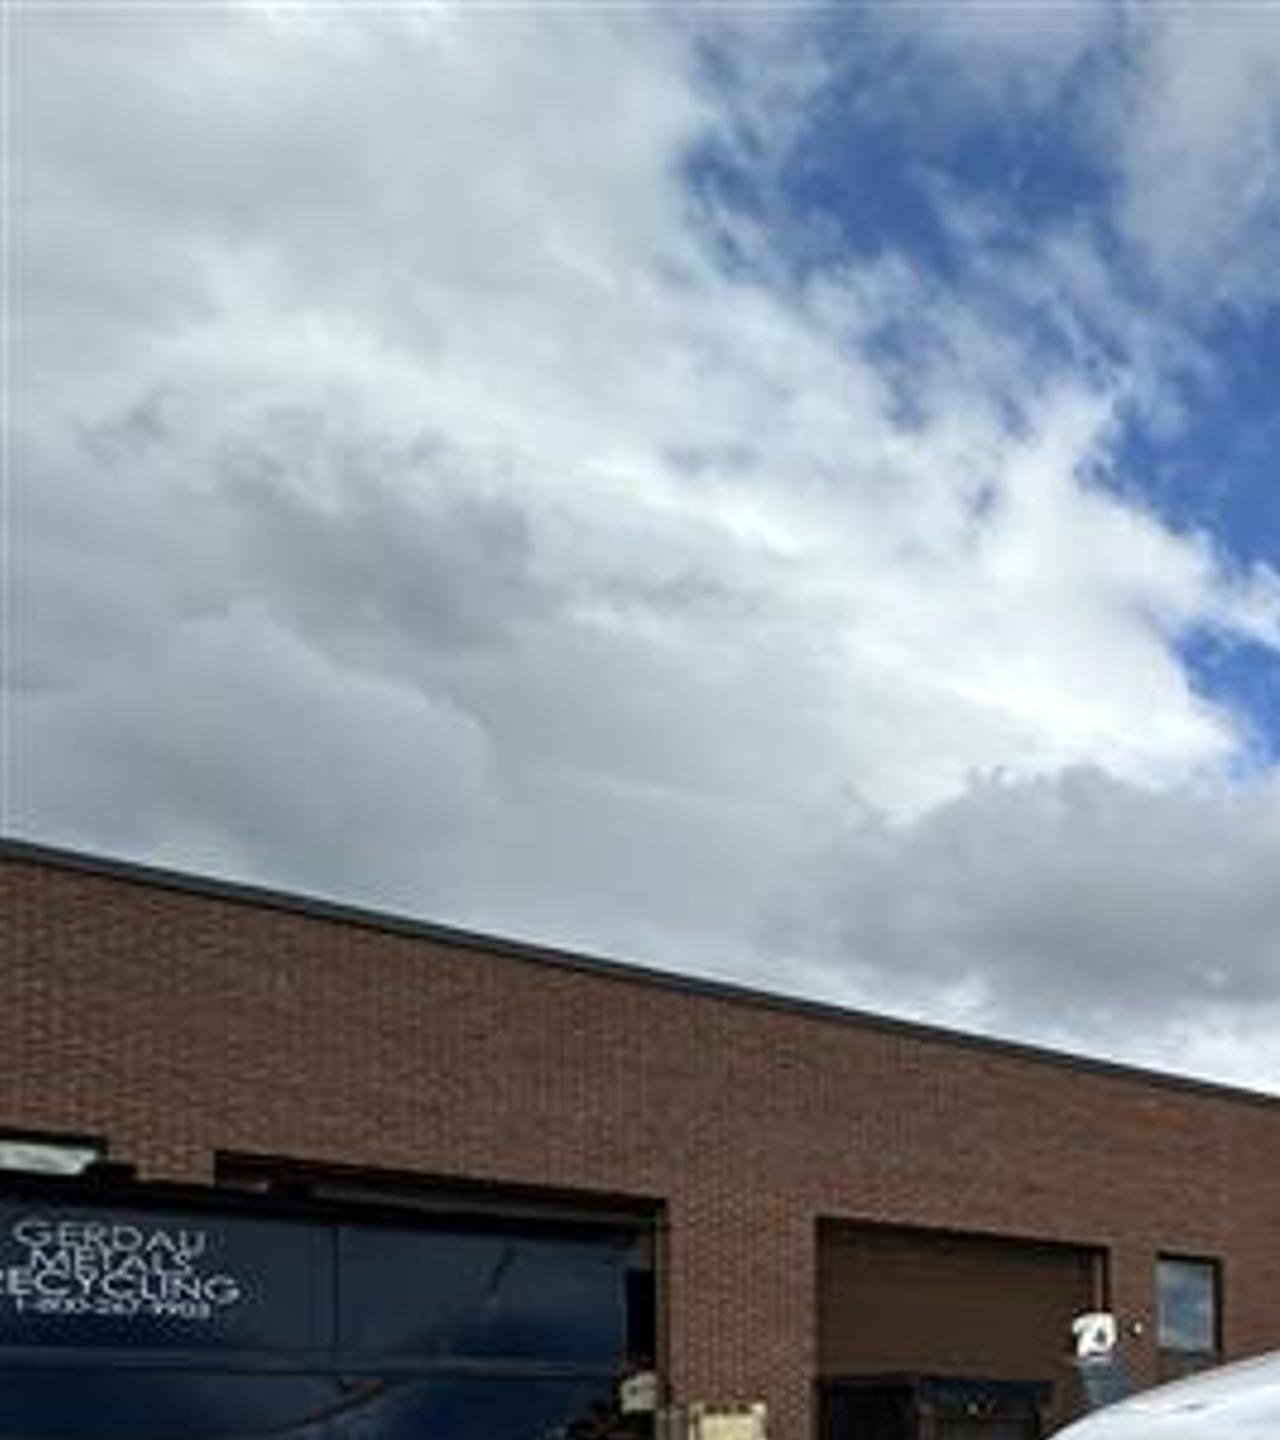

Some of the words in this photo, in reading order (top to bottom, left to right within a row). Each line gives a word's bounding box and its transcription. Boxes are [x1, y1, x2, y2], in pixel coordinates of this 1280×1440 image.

[12, 1220, 206, 1256] GERDAU
[29, 1247, 193, 1277] METALS
[0, 1266, 240, 1304] ECYCLING
